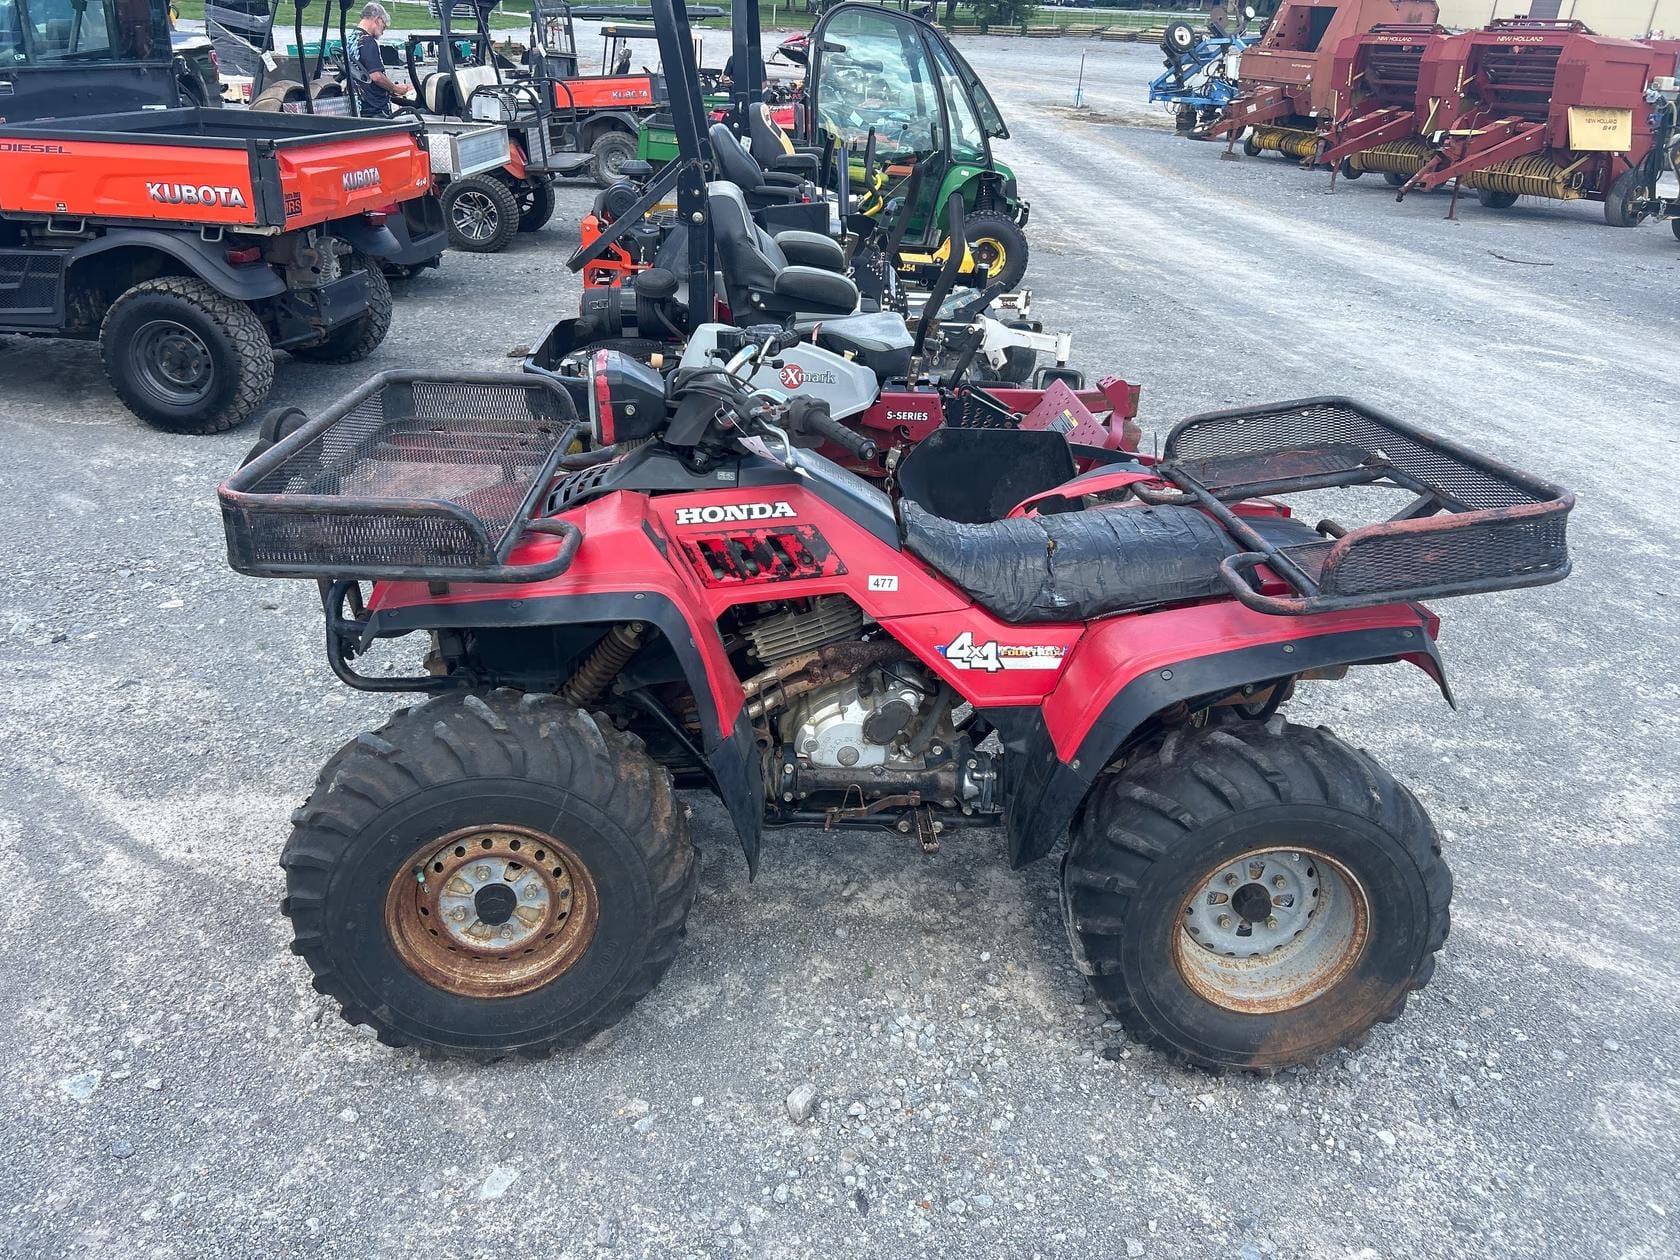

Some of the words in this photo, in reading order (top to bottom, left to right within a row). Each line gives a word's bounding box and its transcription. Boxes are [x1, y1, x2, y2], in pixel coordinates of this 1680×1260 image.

[0, 143, 72, 154] DIESEL
[342, 167, 382, 191] KUBOTA
[145, 182, 248, 208] KUBOTA
[886, 411, 928, 421] S-SERIES
[675, 501, 798, 525] HONDA
[873, 578, 893, 589] 477
[945, 631, 1005, 673] 4x4
